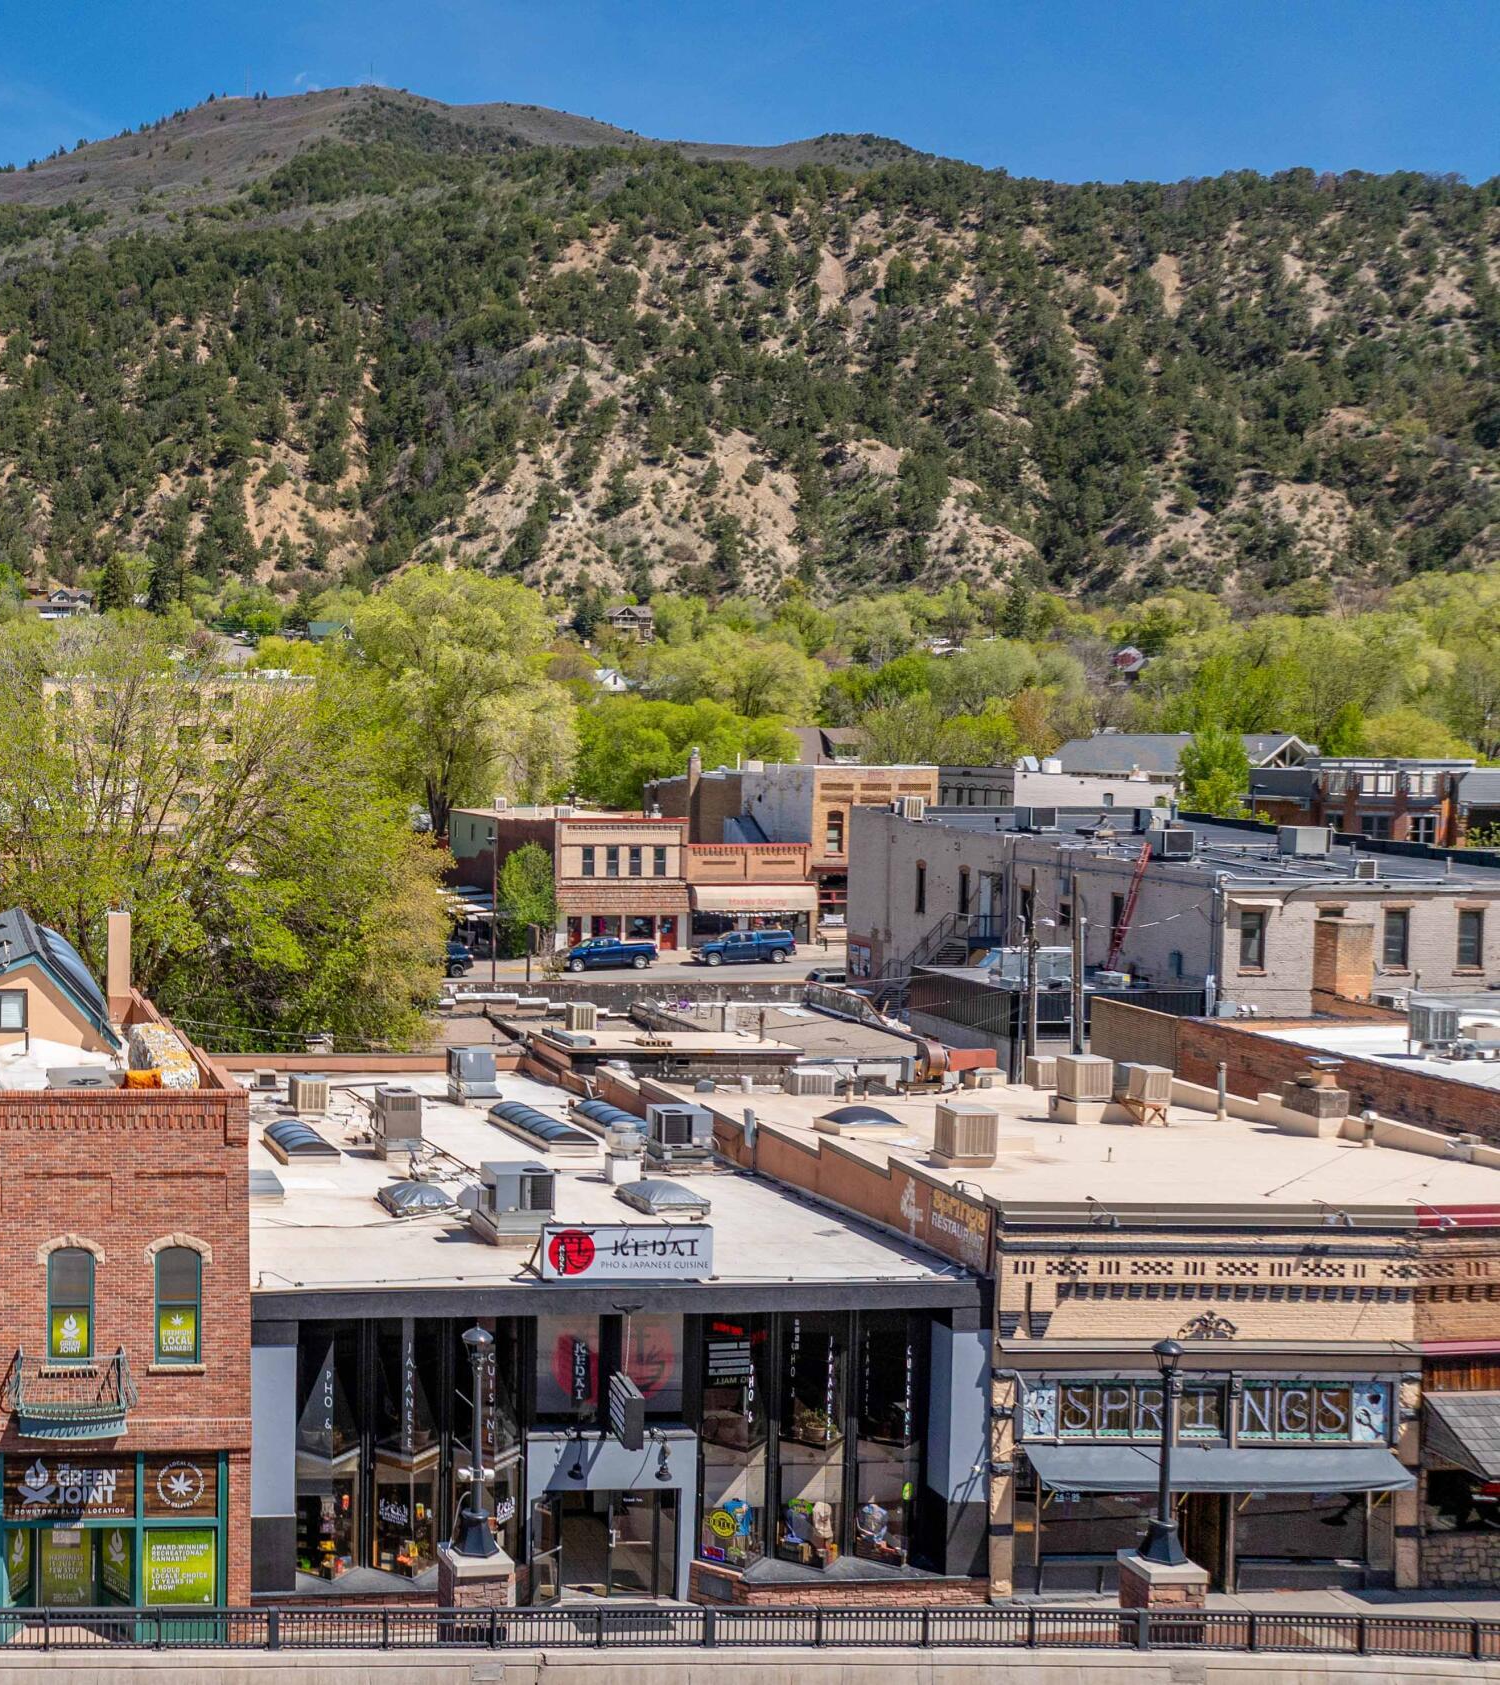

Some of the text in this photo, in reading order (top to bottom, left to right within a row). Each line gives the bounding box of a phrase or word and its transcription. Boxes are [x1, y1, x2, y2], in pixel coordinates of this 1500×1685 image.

[611, 1238, 699, 1257] KEDAI
[601, 1260, 709, 1269] PHO & JAPANESE CUISINE
[162, 1336, 193, 1345] LOCAL
[324, 1370, 333, 1408] PHO
[405, 1341, 414, 1449] JAPANESE
[487, 1352, 496, 1444] CUISINE
[1064, 1387, 1346, 1432] SPRINGS
[56, 1469, 116, 1486] GREEN
[56, 1486, 116, 1504] JOINT
